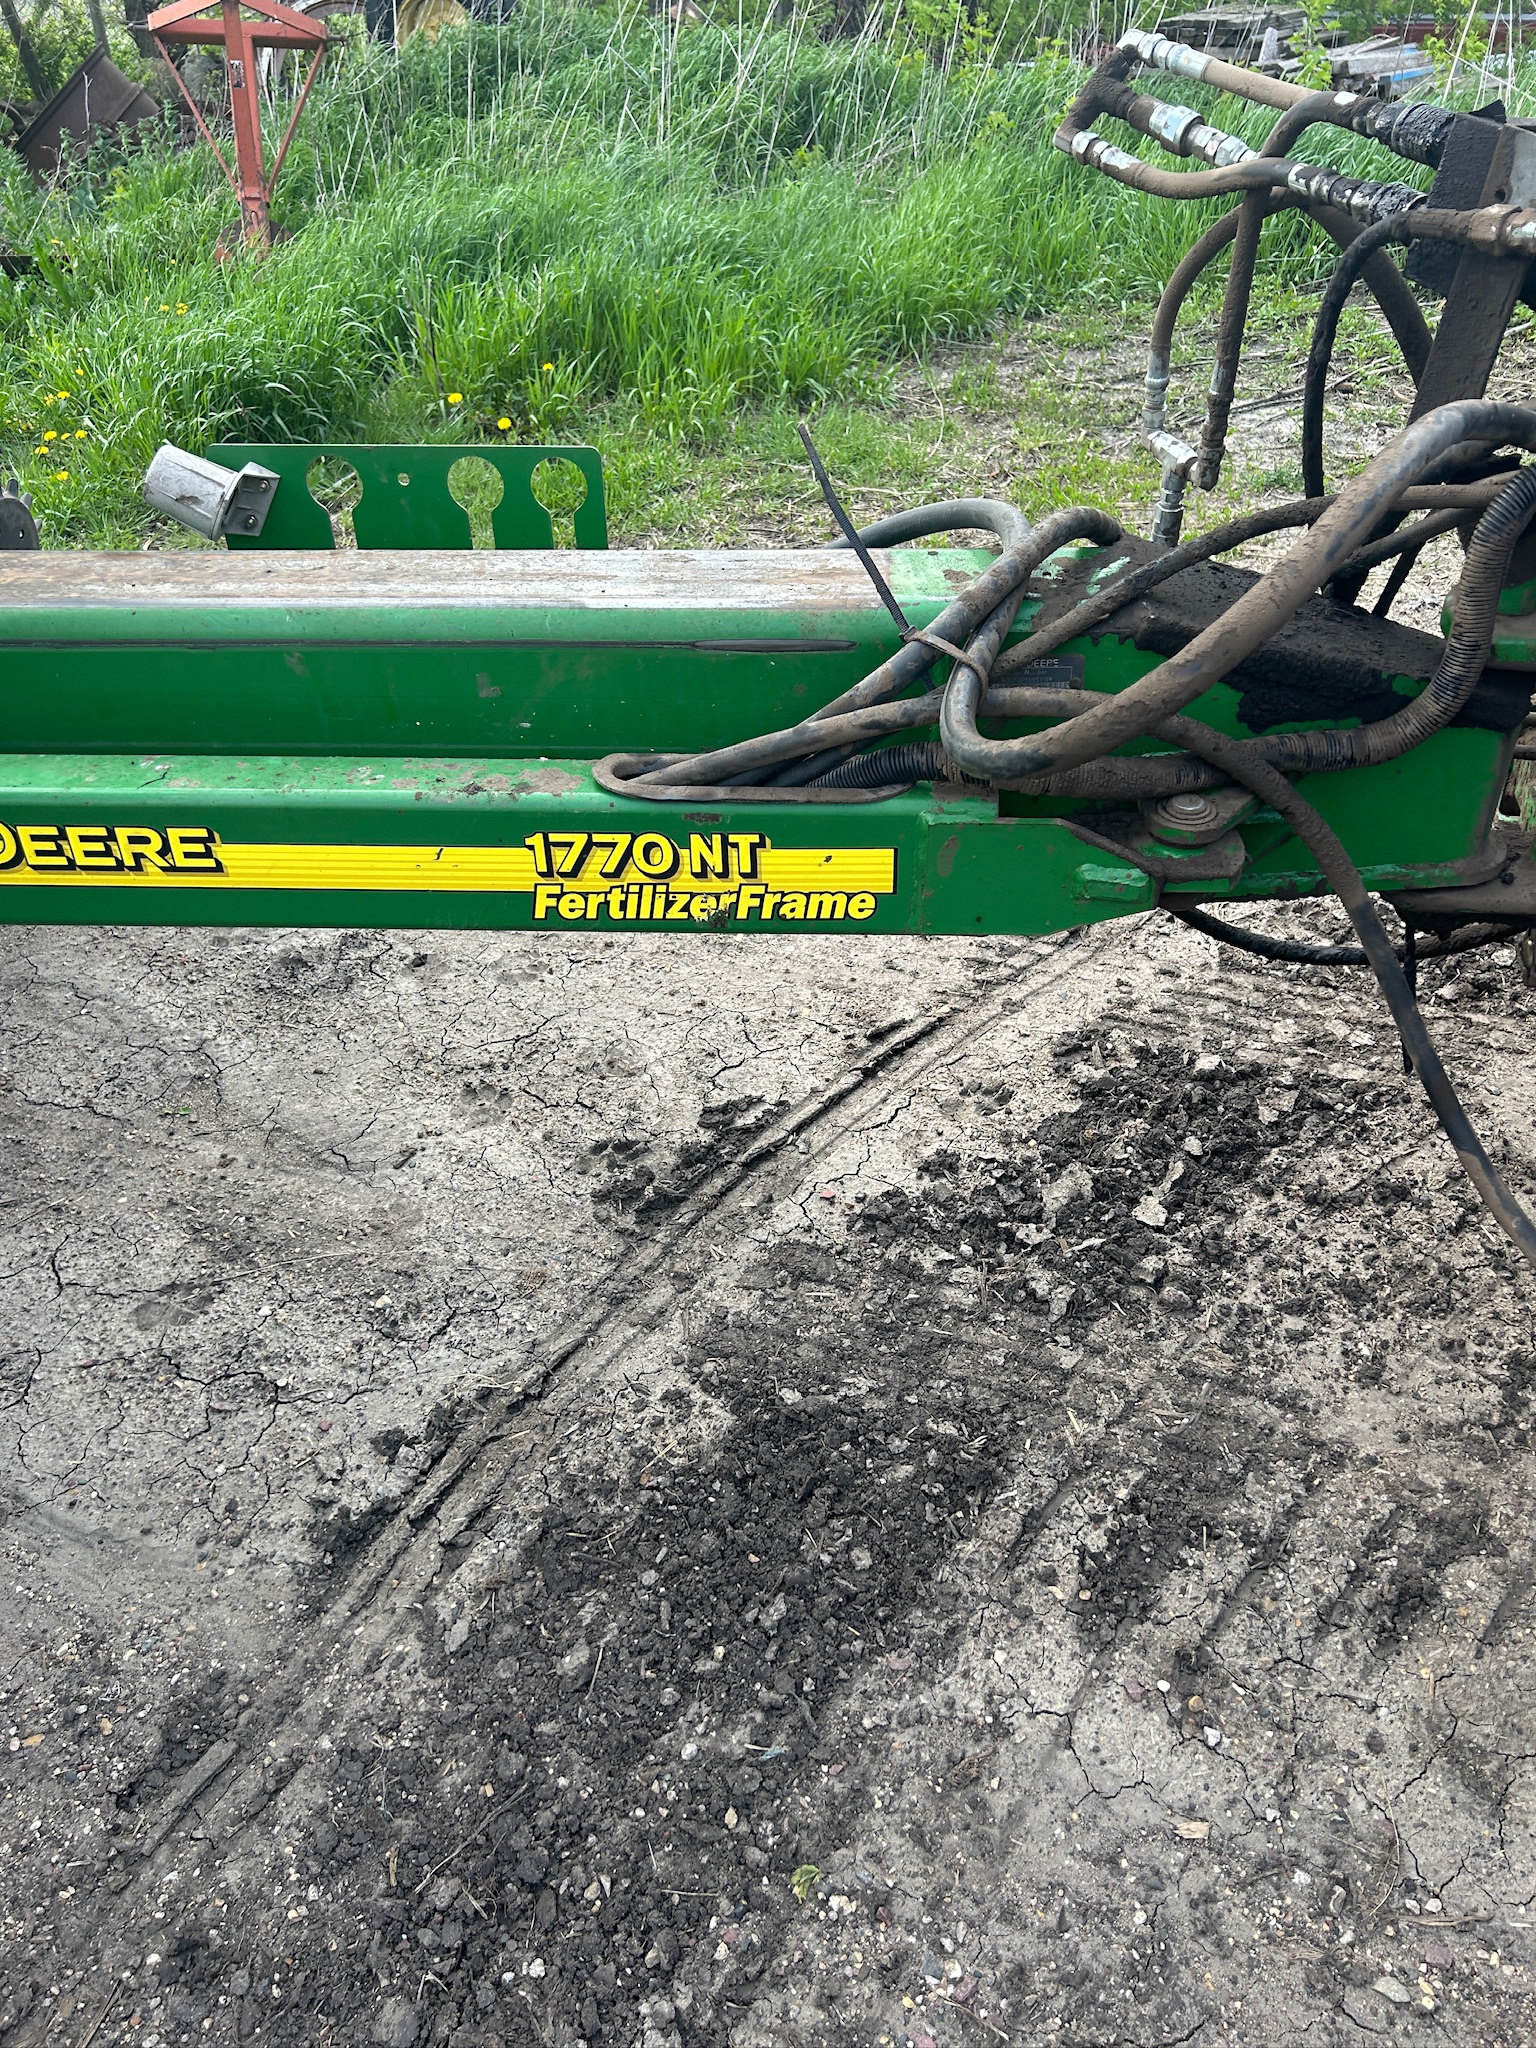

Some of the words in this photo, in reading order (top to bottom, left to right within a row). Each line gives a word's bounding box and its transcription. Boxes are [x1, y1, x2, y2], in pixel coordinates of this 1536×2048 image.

[524, 832, 682, 879] 1770
[689, 833, 767, 878] NT
[532, 883, 878, 921] FertilizerFrame
